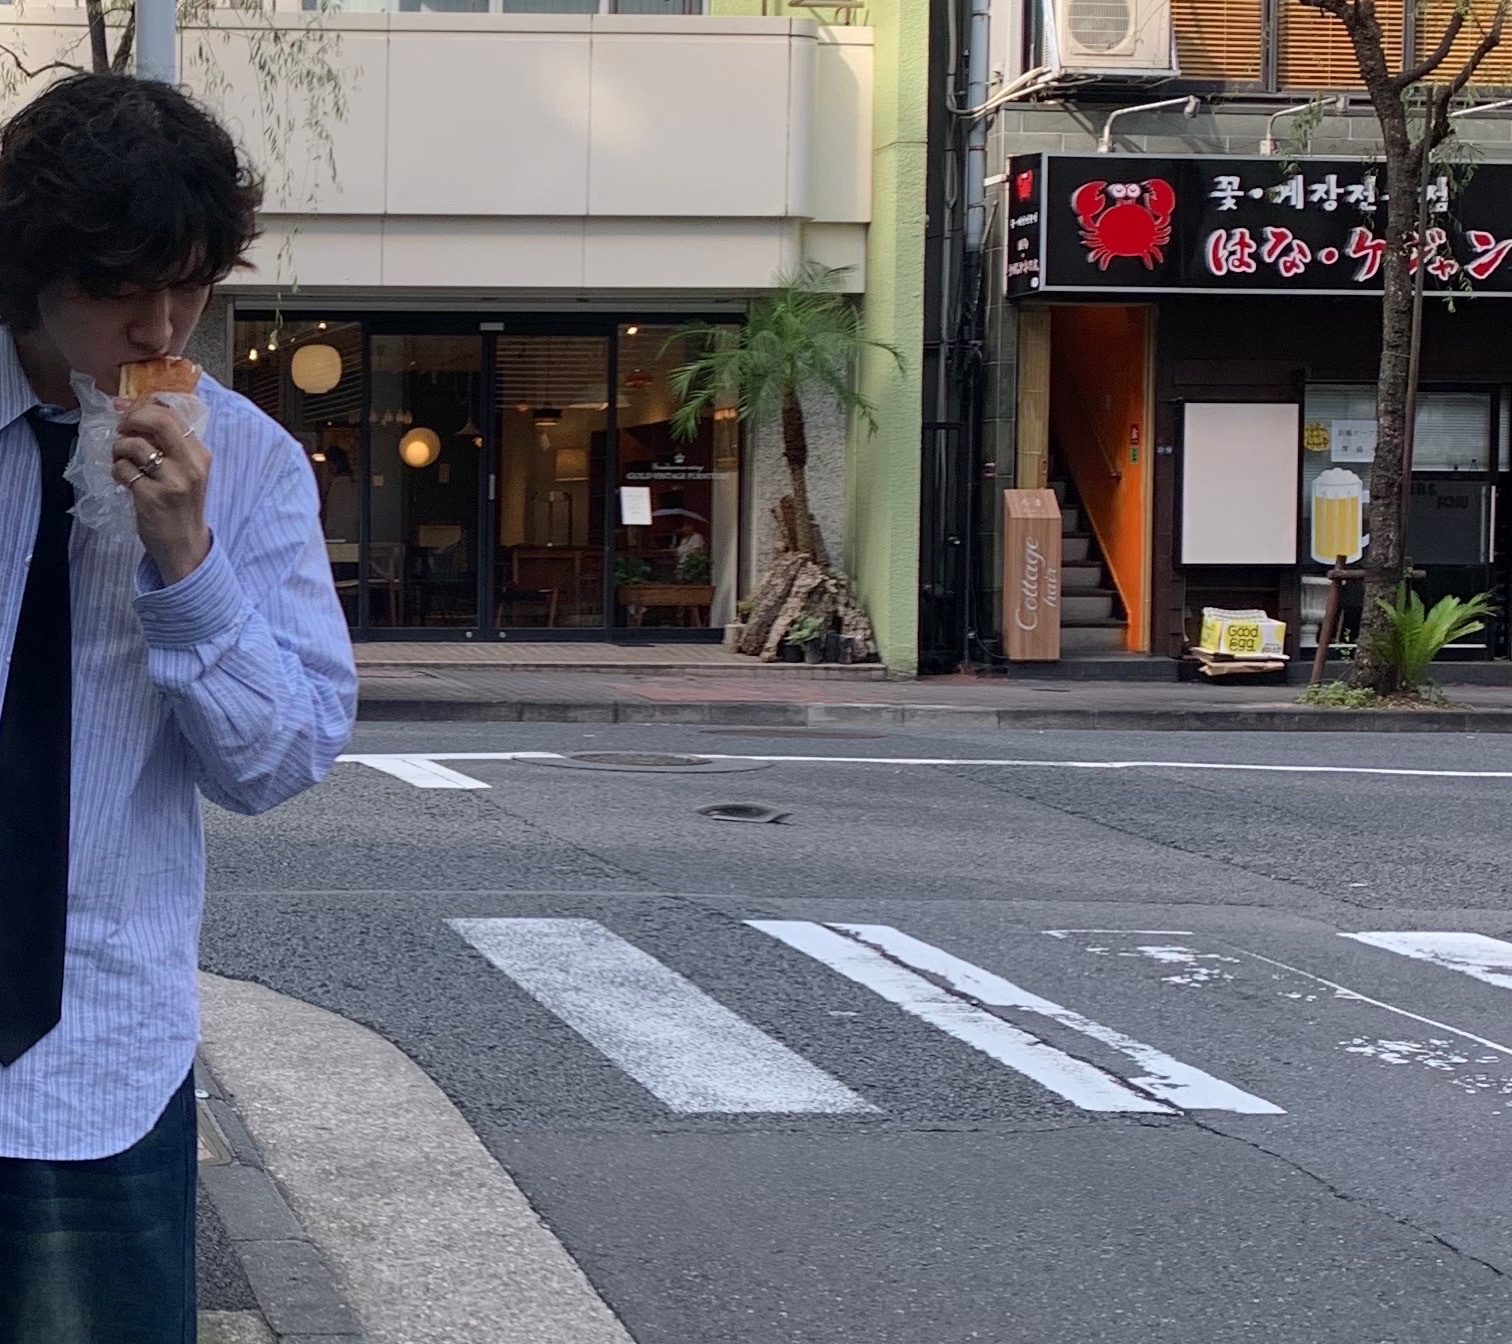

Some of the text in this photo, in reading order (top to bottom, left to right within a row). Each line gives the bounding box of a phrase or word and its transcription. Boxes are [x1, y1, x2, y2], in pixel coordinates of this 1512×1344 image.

[1208, 173, 1449, 212] 꽃·게장전점
[1015, 537, 1046, 631] Cottage
[1043, 567, 1057, 608] hair
[1228, 625, 1259, 637] Good
